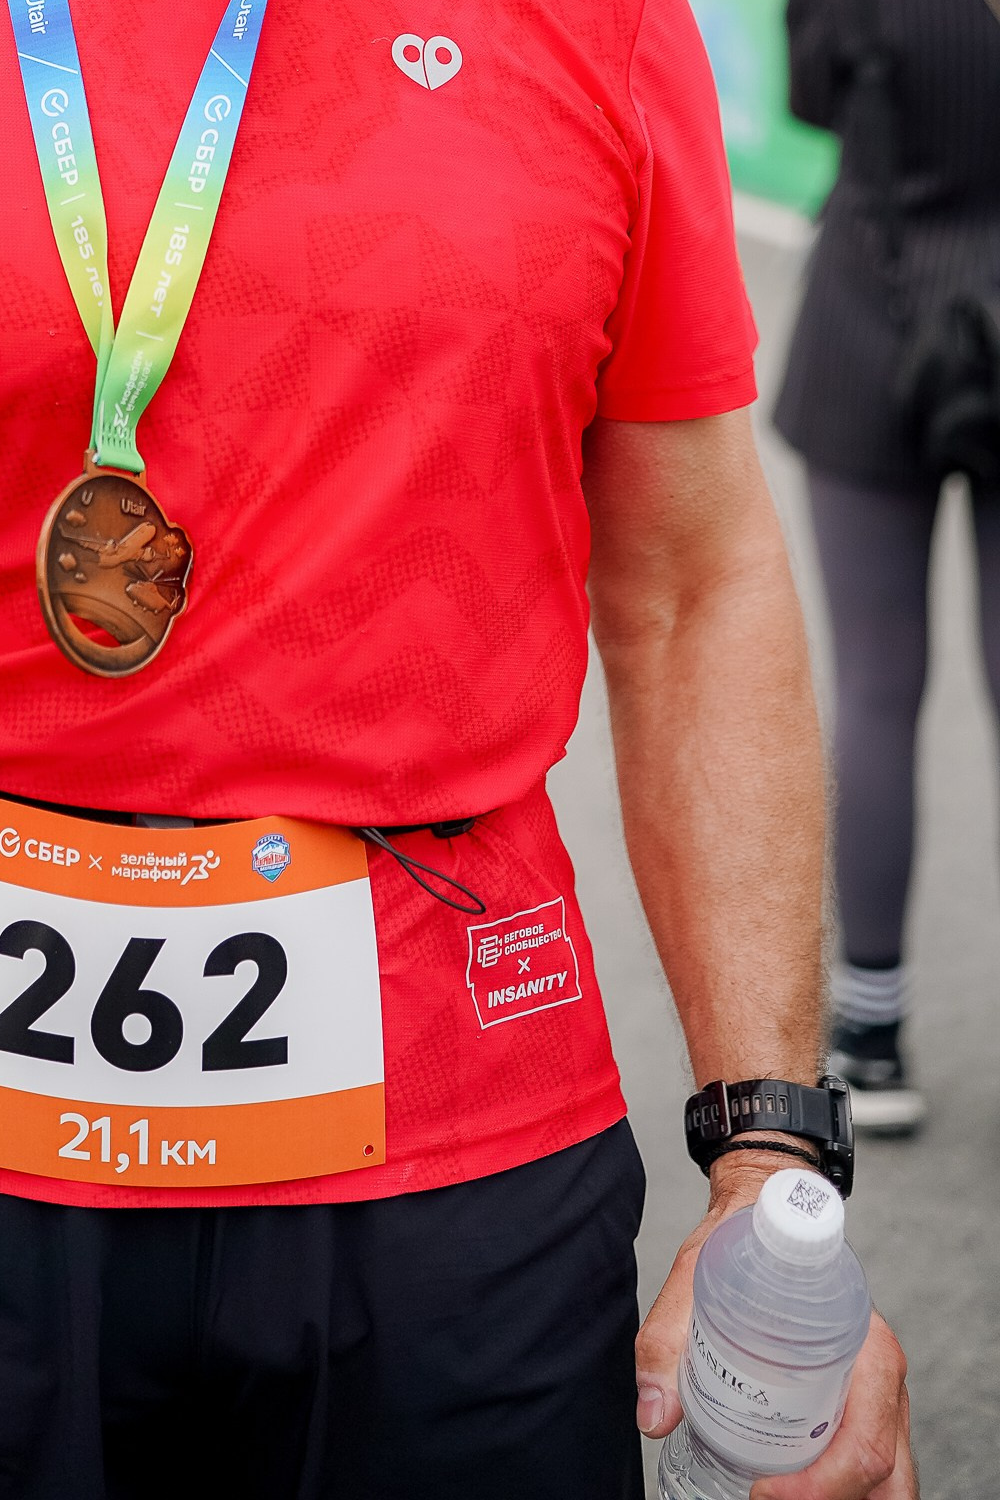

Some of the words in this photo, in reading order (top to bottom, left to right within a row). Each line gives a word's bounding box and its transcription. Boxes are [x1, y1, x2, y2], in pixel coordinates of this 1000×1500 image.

[188, 129, 219, 193] СБЕР
[51, 122, 80, 186] СБЕР
[70, 215, 95, 260] 185
[164, 224, 190, 266] 185
[150, 270, 174, 319] лет
[121, 498, 147, 516] Utair
[24, 838, 80, 867] СБЕР
[120, 850, 188, 867] зелёный
[111, 864, 181, 884] марафон
[504, 923, 545, 944] БЕГОВОЕ
[504, 928, 562, 956] СООБЩЕСТВО
[488, 970, 568, 1009] INSANITY
[58, 1111, 150, 1174] 21,1
